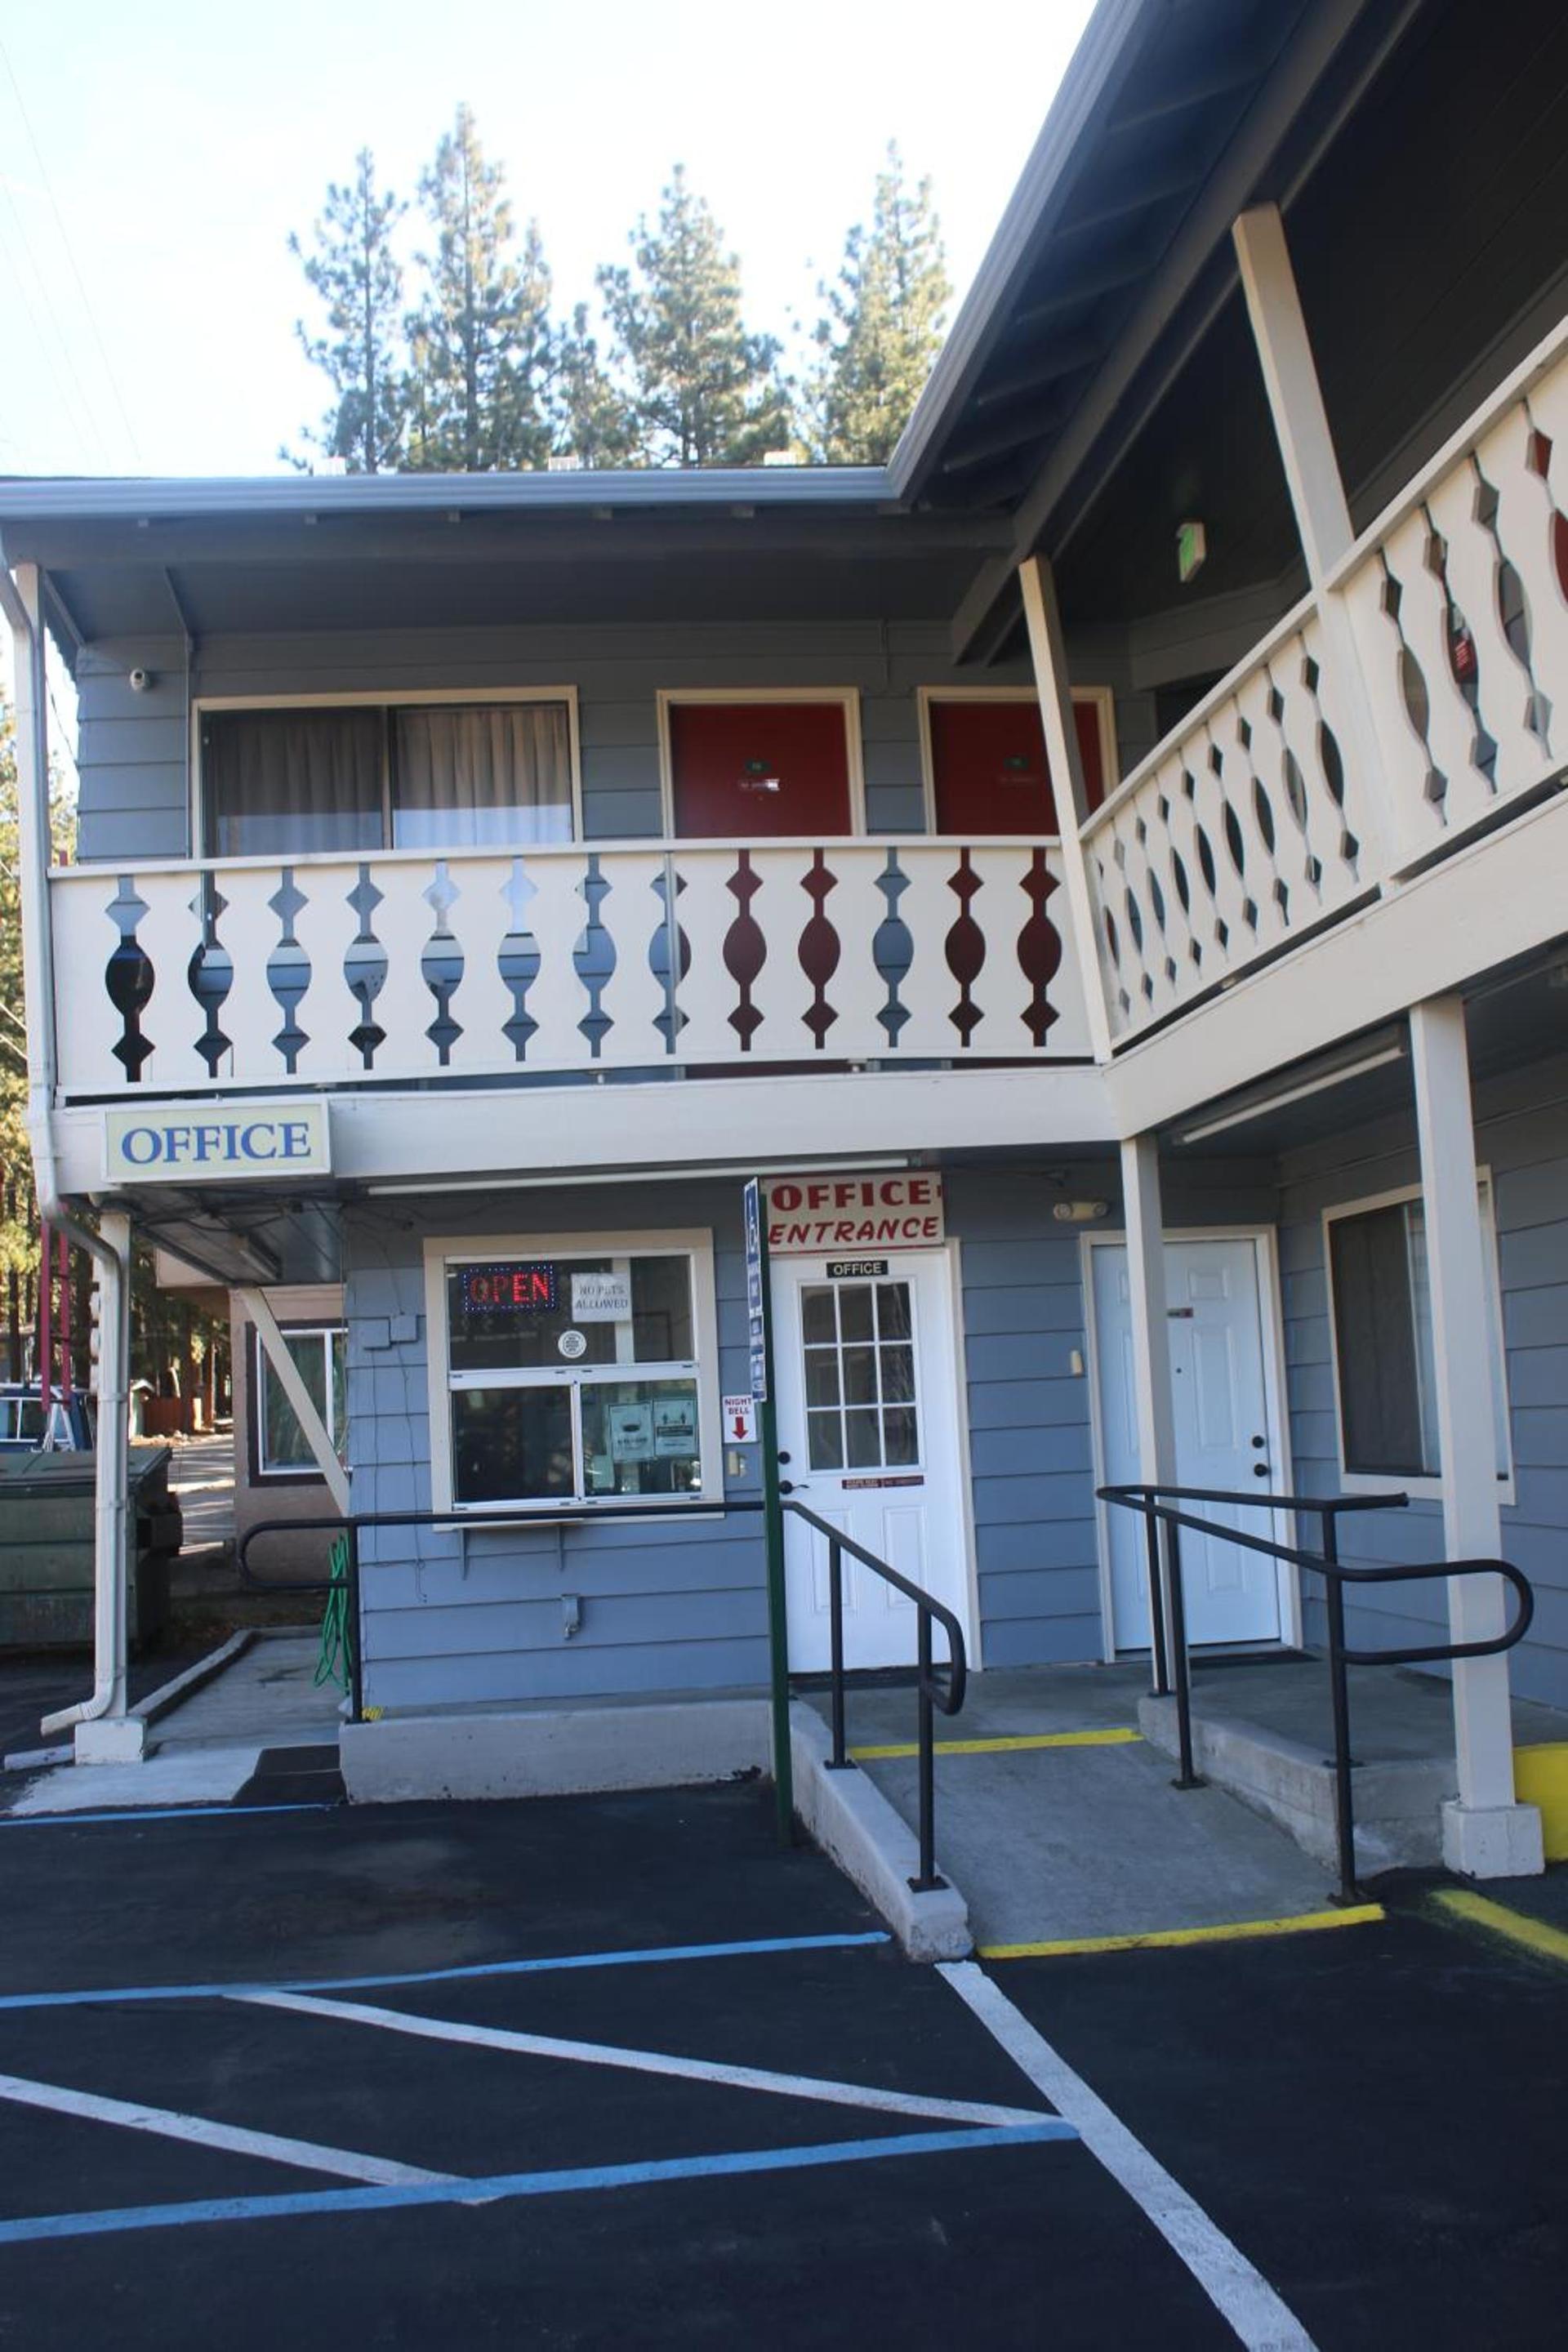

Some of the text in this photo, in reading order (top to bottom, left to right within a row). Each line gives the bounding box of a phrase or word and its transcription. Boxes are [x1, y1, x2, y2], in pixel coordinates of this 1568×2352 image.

[122, 1122, 311, 1164] OFFICE
[771, 1180, 931, 1211] OFFICE
[768, 1216, 938, 1245] ENTRANCE
[833, 1263, 882, 1276] OFFICE
[470, 1272, 549, 1303] OPEN
[580, 1285, 595, 1294] NO
[576, 1298, 628, 1309] ALLOWED
[725, 1397, 751, 1405] NIGHT
